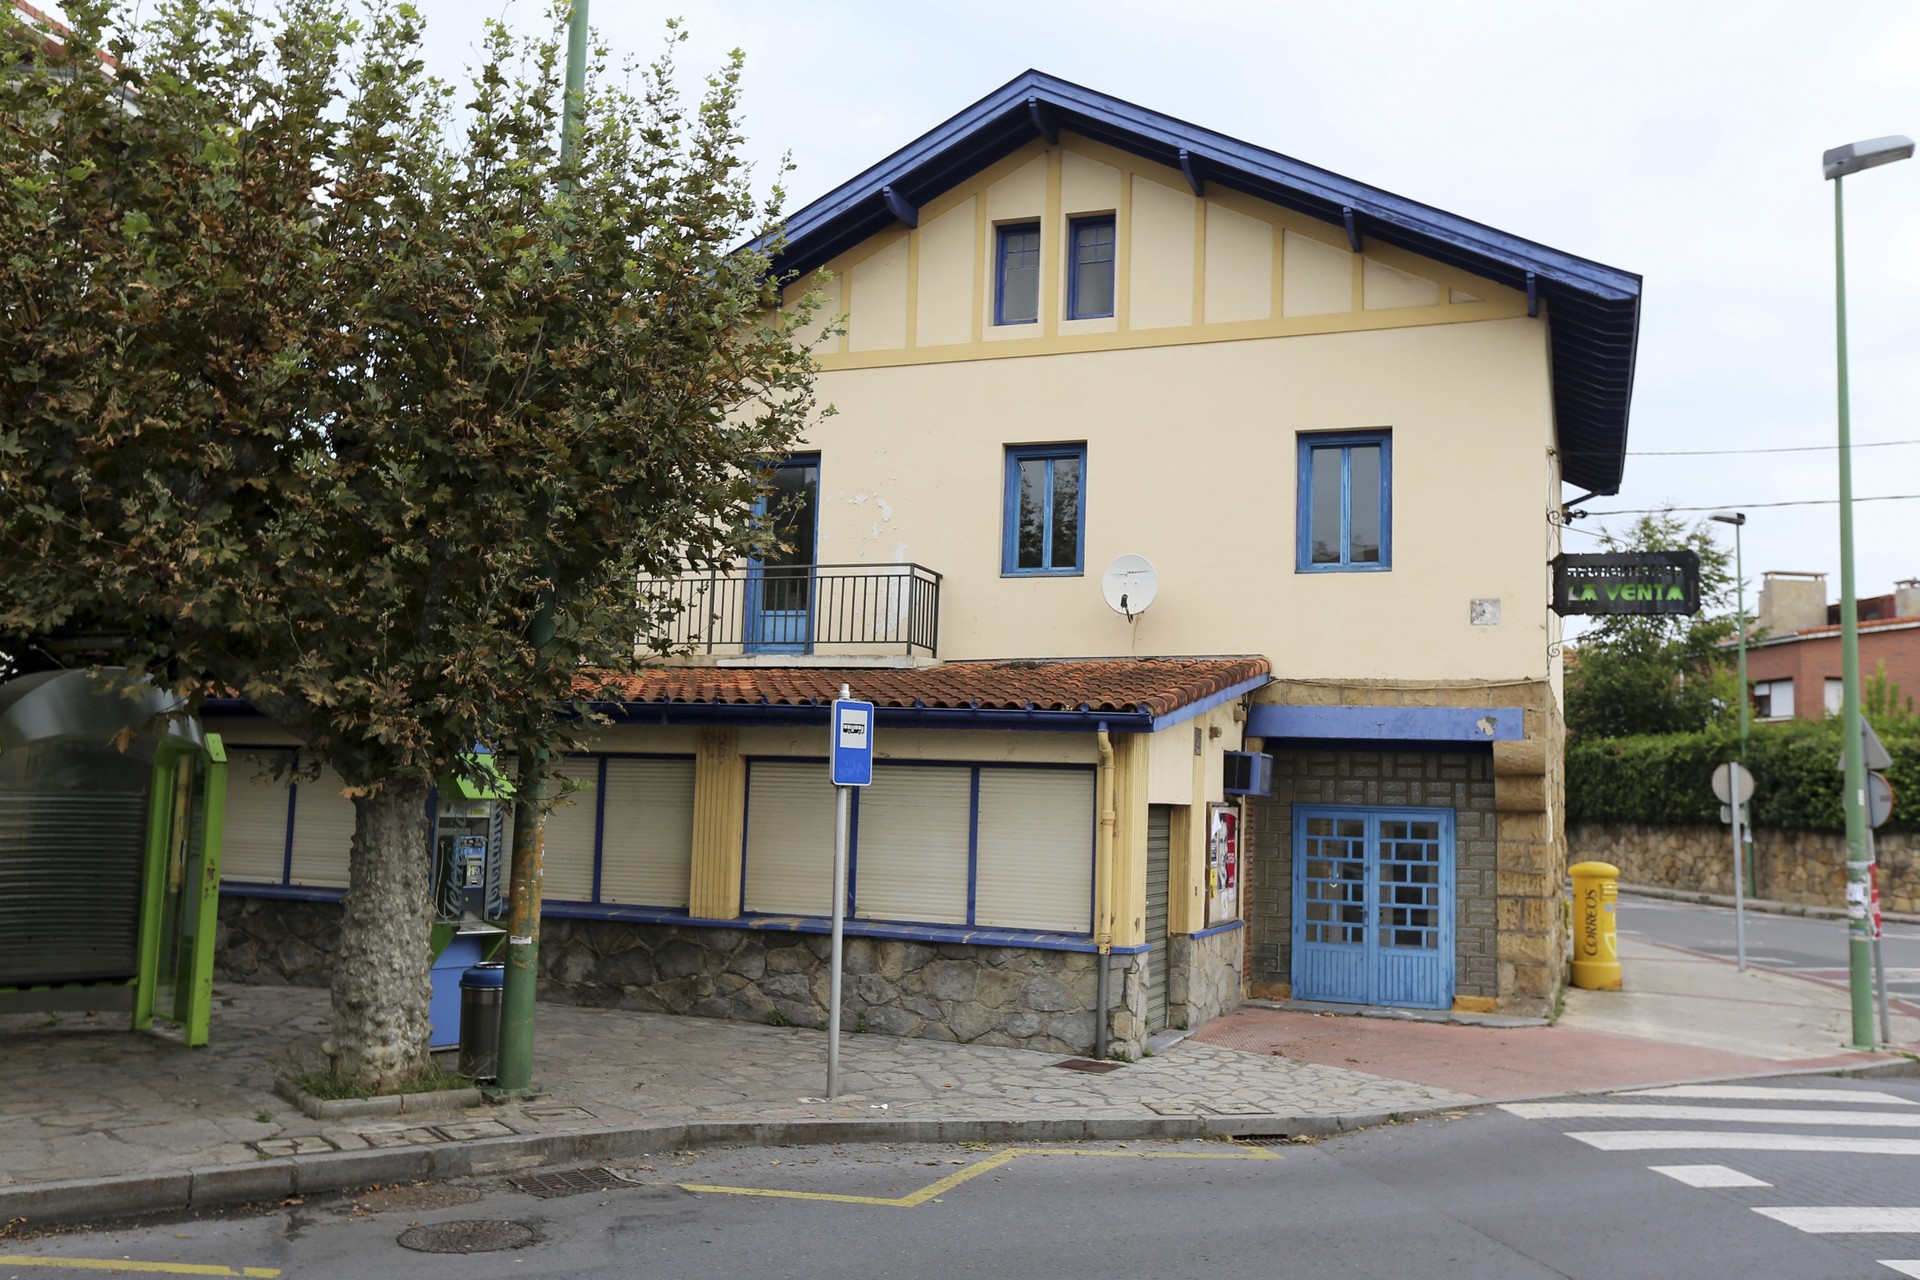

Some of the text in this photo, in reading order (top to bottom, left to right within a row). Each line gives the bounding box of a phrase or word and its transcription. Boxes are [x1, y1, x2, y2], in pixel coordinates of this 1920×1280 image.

[1568, 583, 1685, 601] LA VENTA
[1583, 889, 1598, 956] CORREOS
